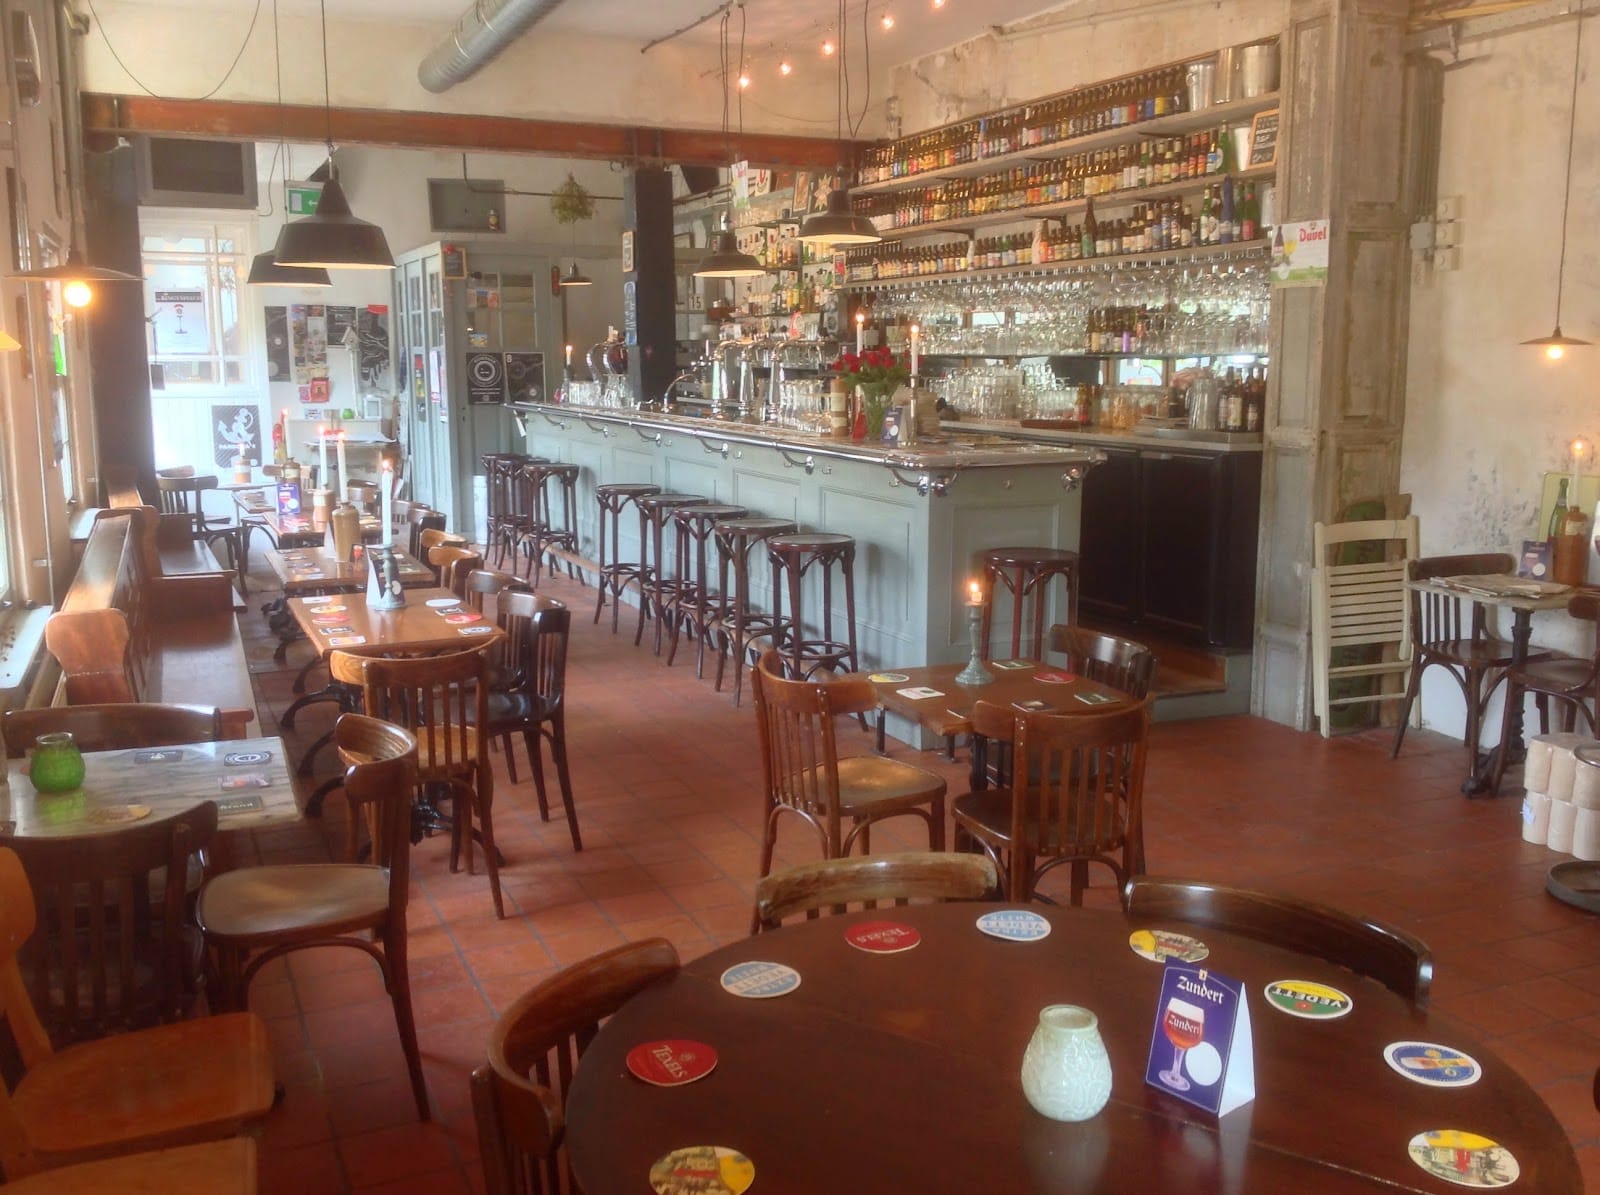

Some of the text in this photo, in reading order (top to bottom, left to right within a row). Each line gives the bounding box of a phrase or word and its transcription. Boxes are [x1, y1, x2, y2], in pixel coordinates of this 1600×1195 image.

[1299, 227, 1326, 242] Duvel
[1177, 976, 1224, 1004] Zundert
[1272, 987, 1342, 1008] VEDETT
[652, 1045, 688, 1078] TEXELS
